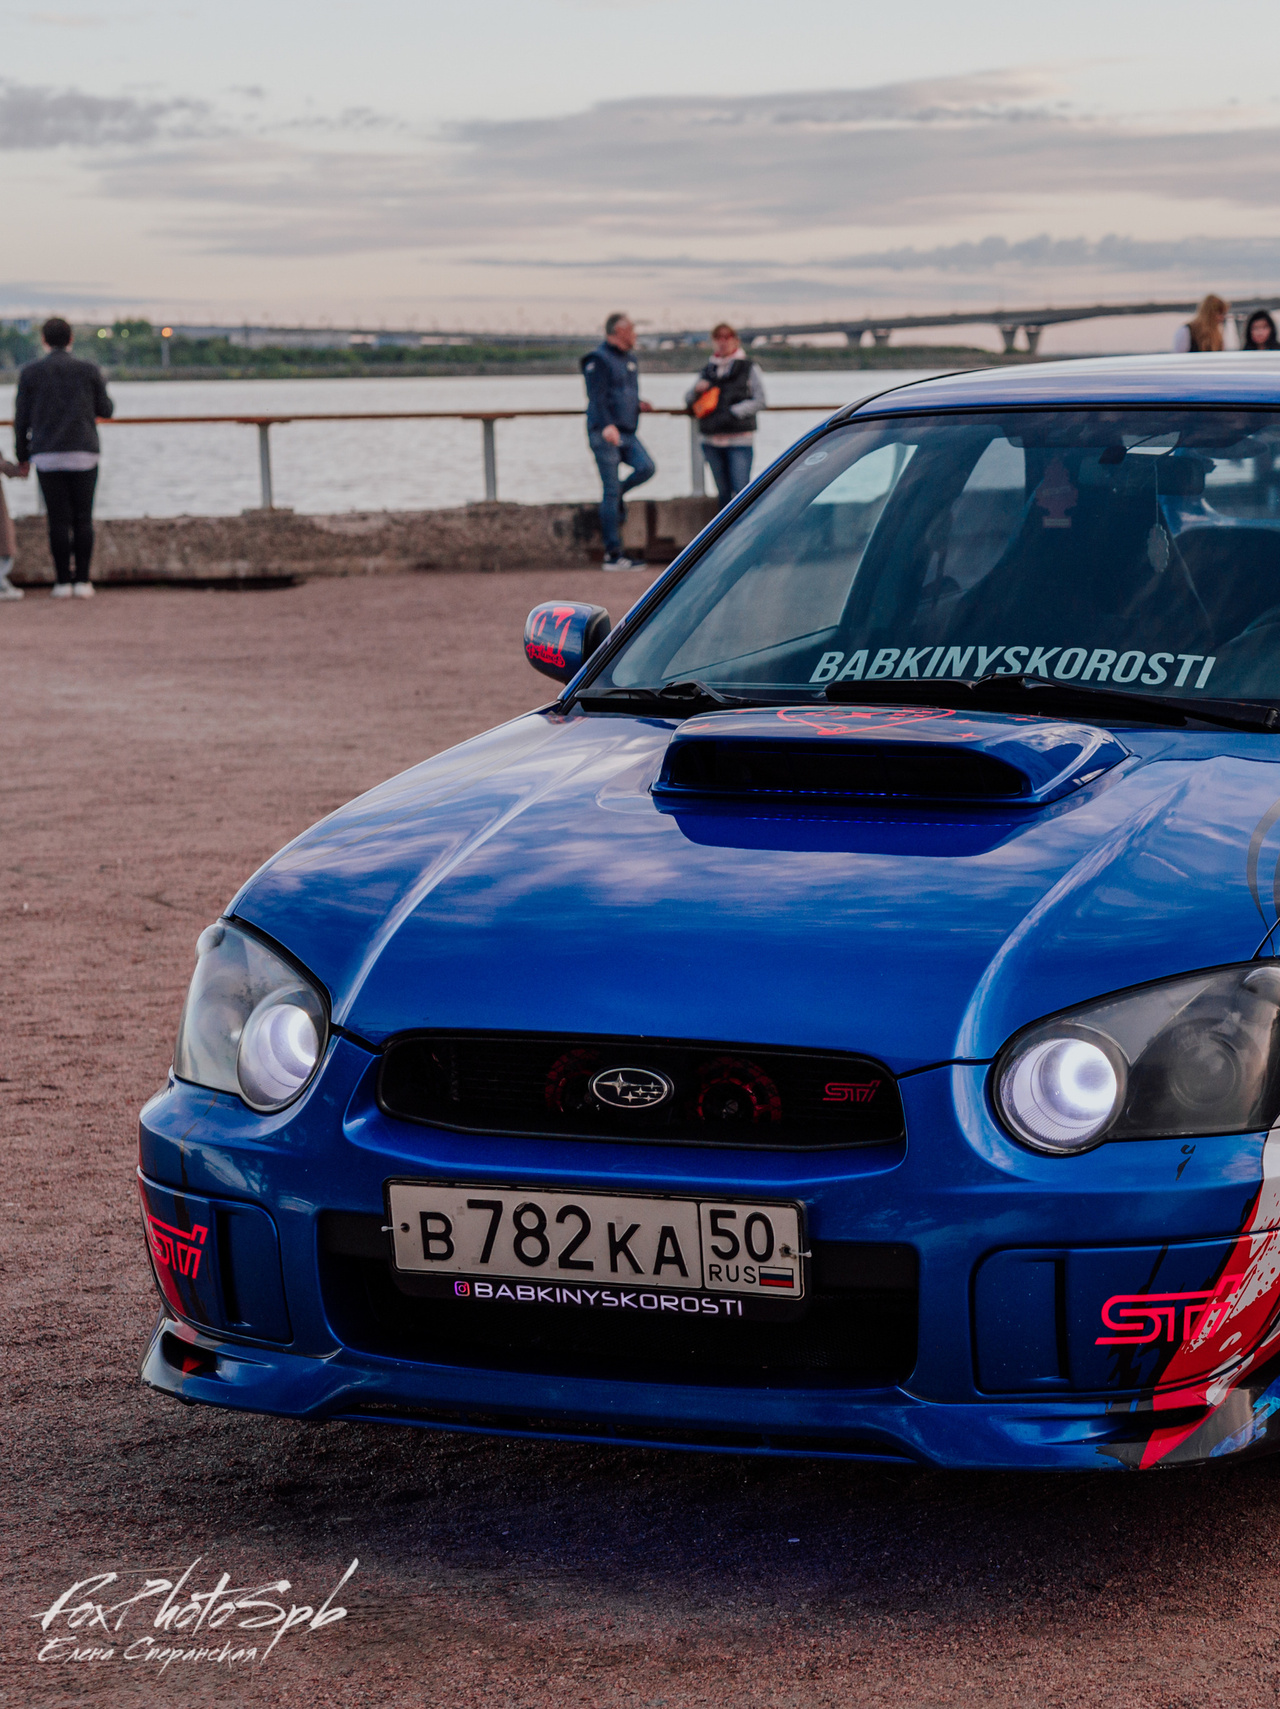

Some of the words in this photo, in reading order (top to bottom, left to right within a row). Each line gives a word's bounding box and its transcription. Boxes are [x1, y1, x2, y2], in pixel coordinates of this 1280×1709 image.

[809, 645, 1217, 688] BABKINYSKOROSTI
[709, 1209, 775, 1263] 50
[709, 1264, 757, 1284] RUS
[475, 1282, 743, 1317] BABKINYSKOROSTI
